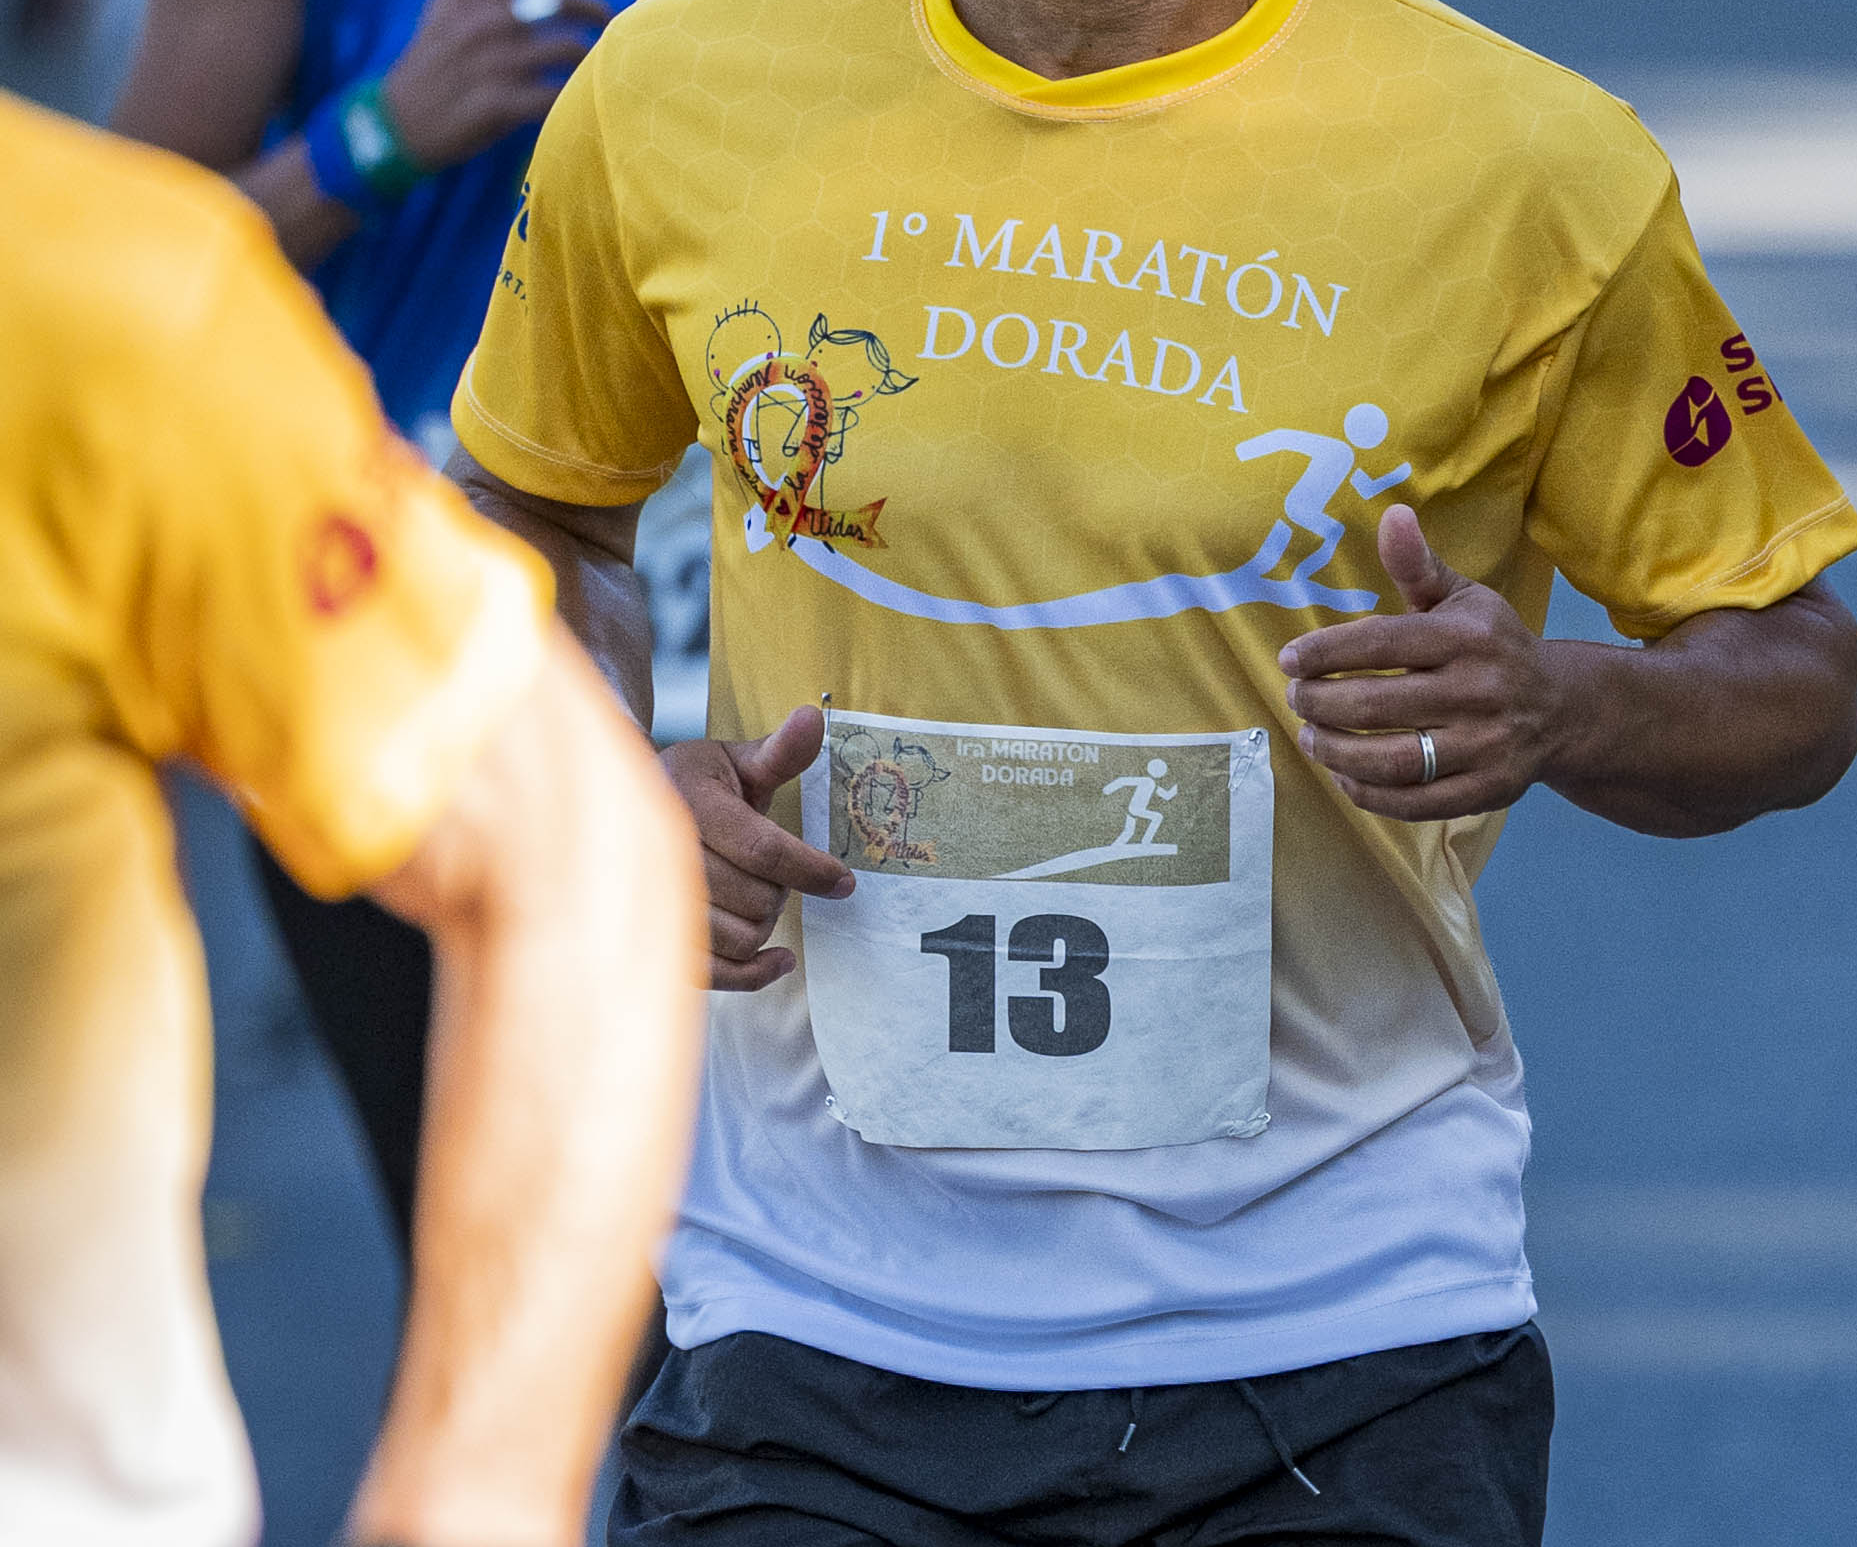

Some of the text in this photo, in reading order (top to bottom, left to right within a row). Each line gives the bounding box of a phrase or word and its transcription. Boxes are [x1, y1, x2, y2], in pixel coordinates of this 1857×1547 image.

[944, 213, 1350, 338] MARATÓN
[916, 305, 1249, 414] DORADA
[982, 764, 1075, 788] DORADA
[992, 739, 1099, 763] MARATON
[920, 913, 1112, 1057] 13
